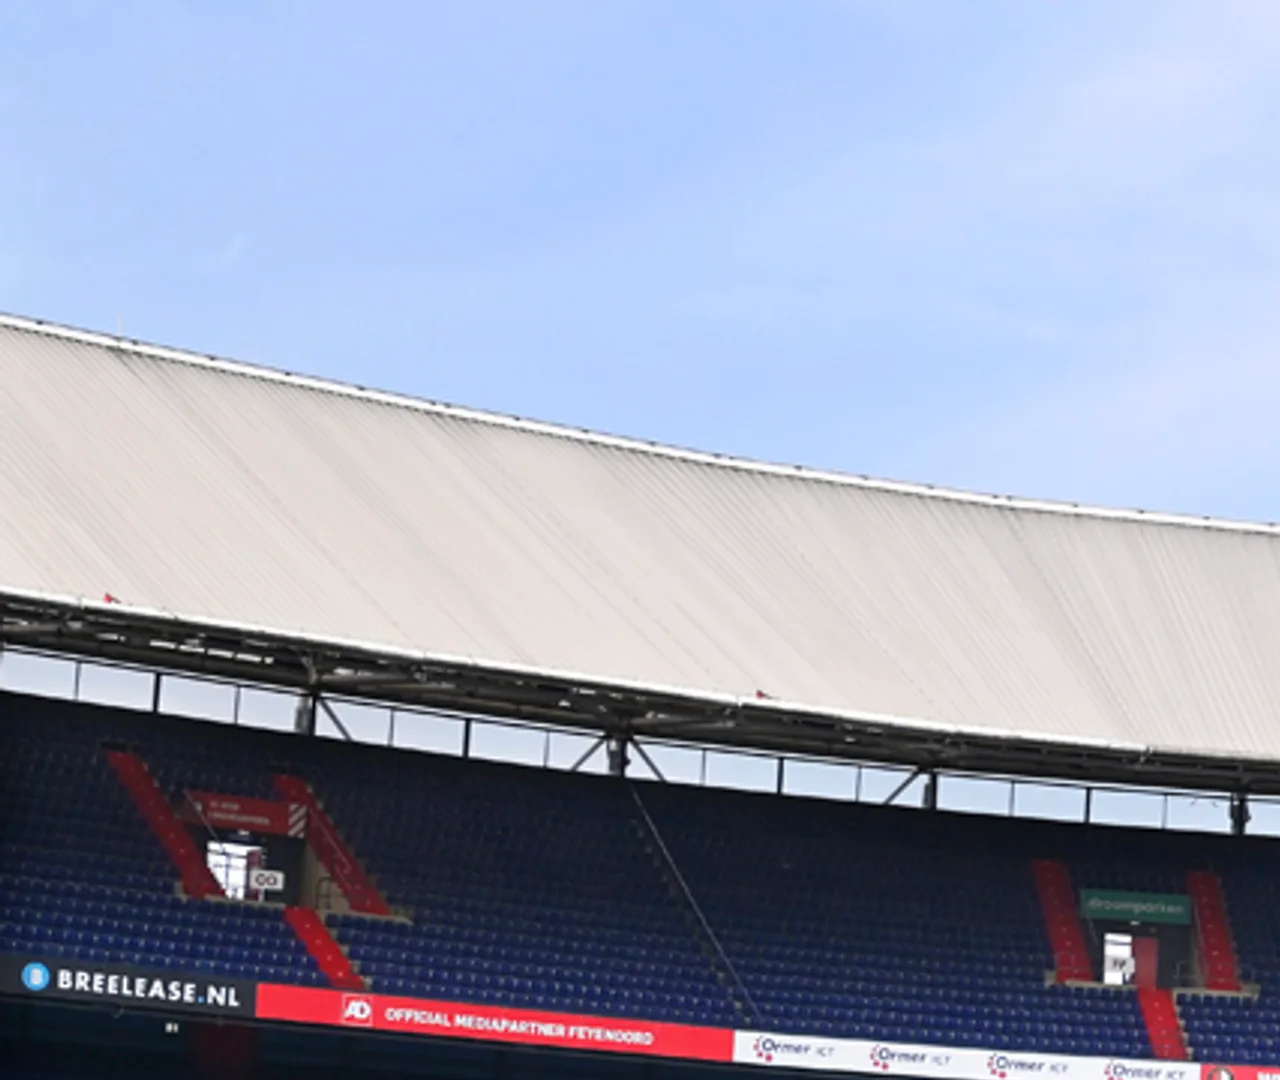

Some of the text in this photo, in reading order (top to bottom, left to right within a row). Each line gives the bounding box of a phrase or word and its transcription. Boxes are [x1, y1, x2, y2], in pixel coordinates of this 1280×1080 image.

[57, 969, 240, 1007] BREELEASE.NL
[385, 1006, 451, 1028] OFFICIAL
[454, 1013, 566, 1038] MEDIAPARTNER
[568, 1024, 655, 1046] FEYENOORD
